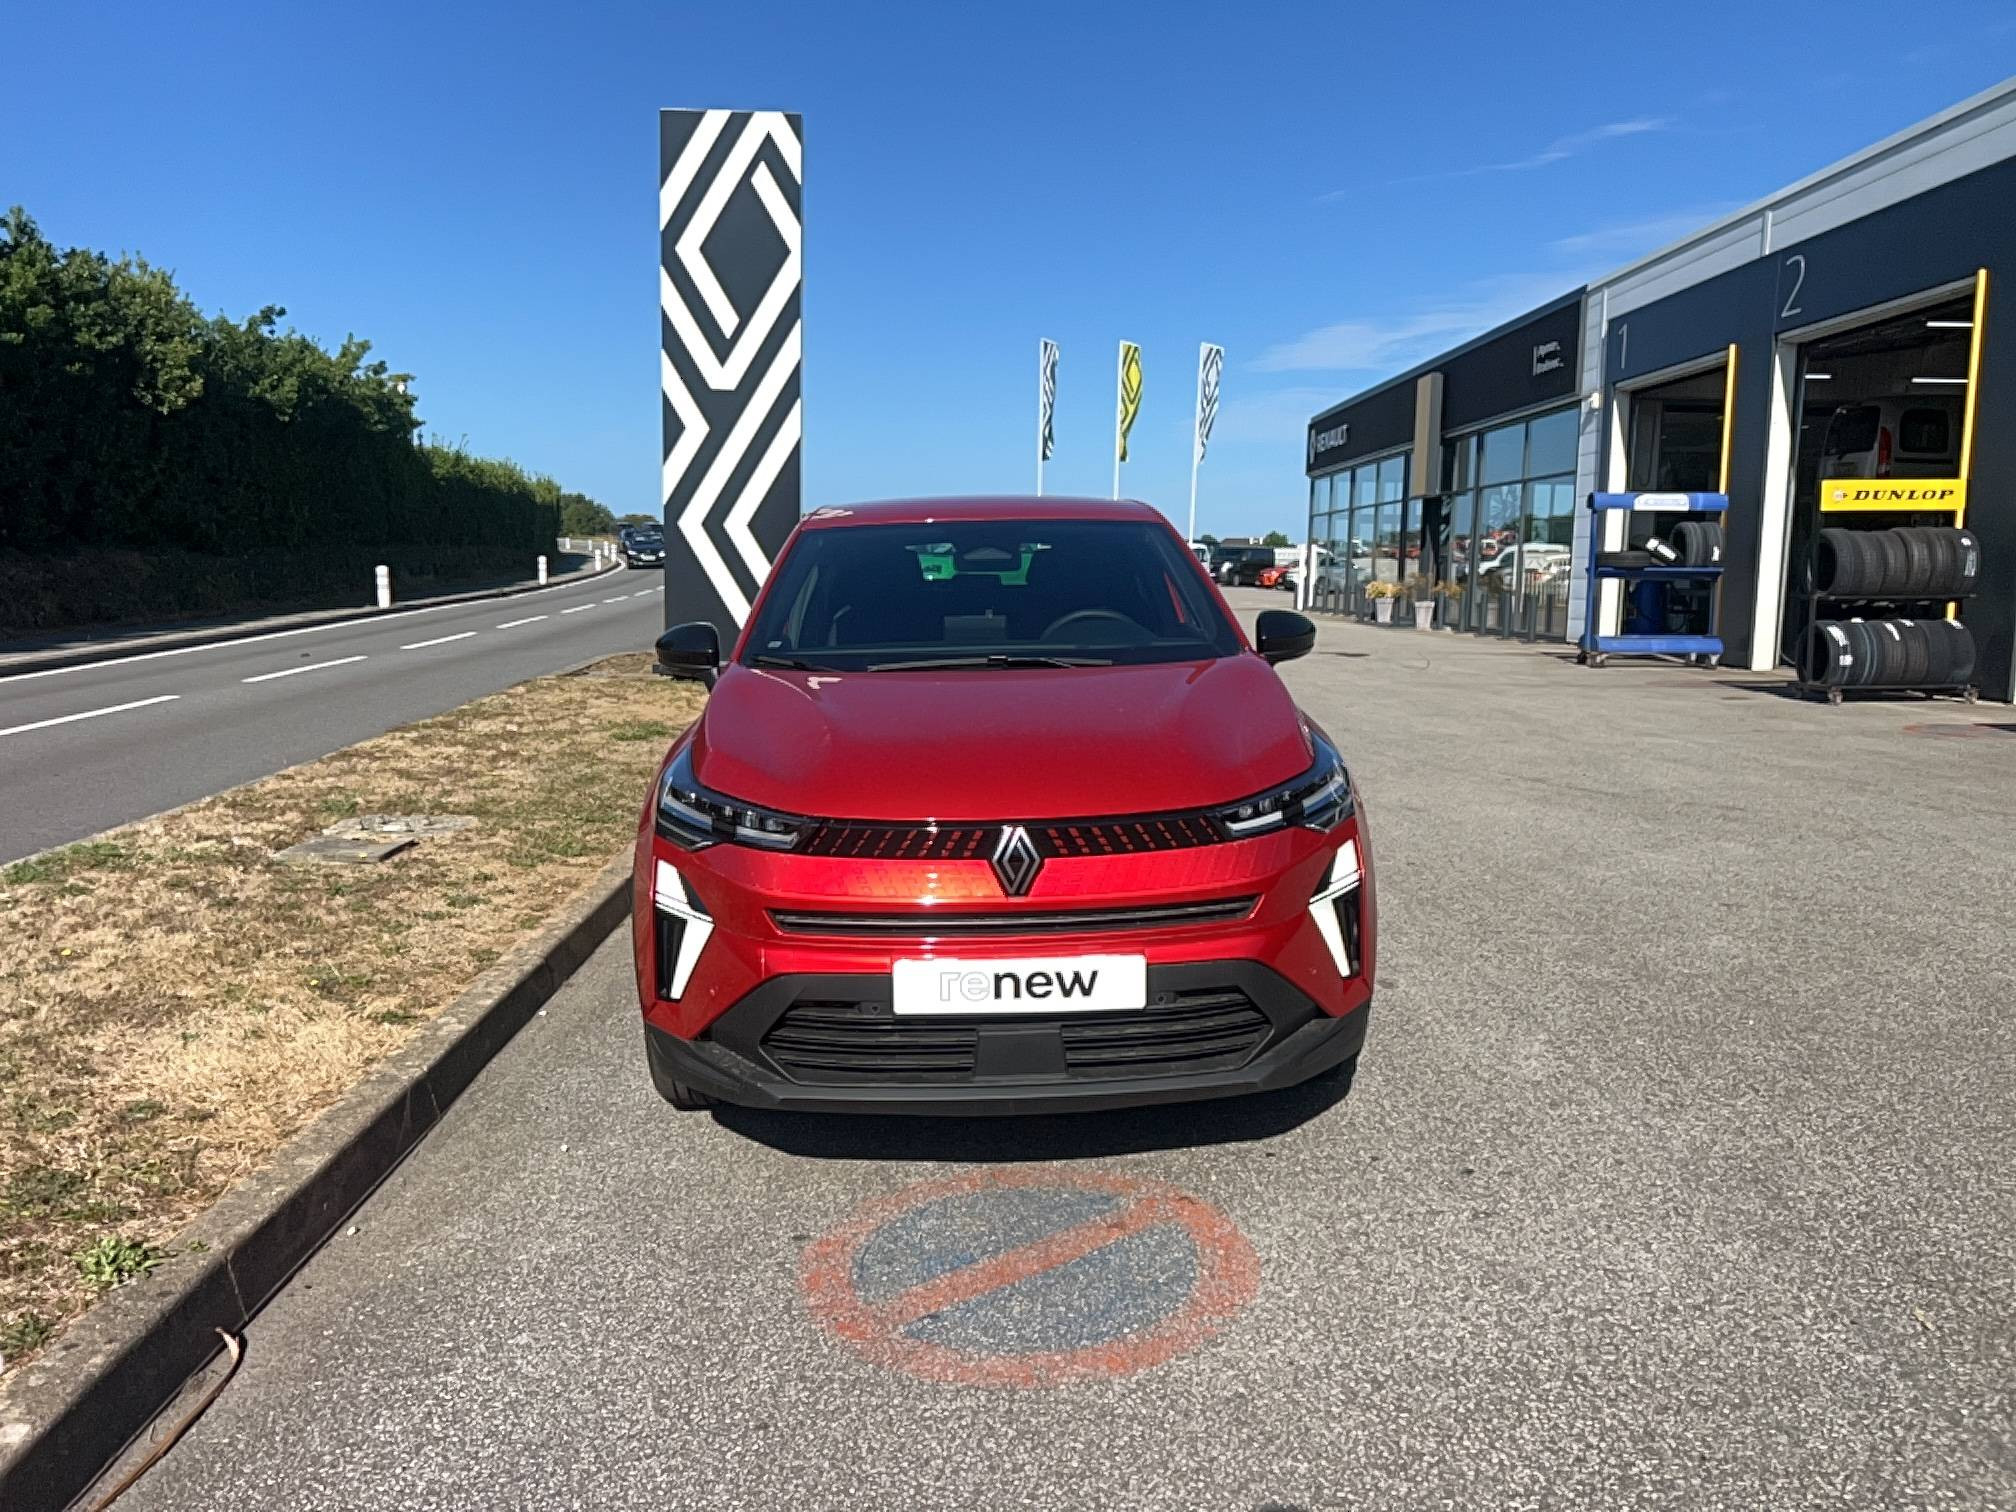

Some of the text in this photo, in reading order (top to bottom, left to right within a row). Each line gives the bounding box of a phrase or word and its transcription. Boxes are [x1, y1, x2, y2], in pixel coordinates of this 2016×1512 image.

[1781, 254, 1807, 318] 2
[1617, 323, 1629, 369] 1
[1852, 489, 1955, 501] DUNLOP
[939, 969, 1099, 1001] renew
